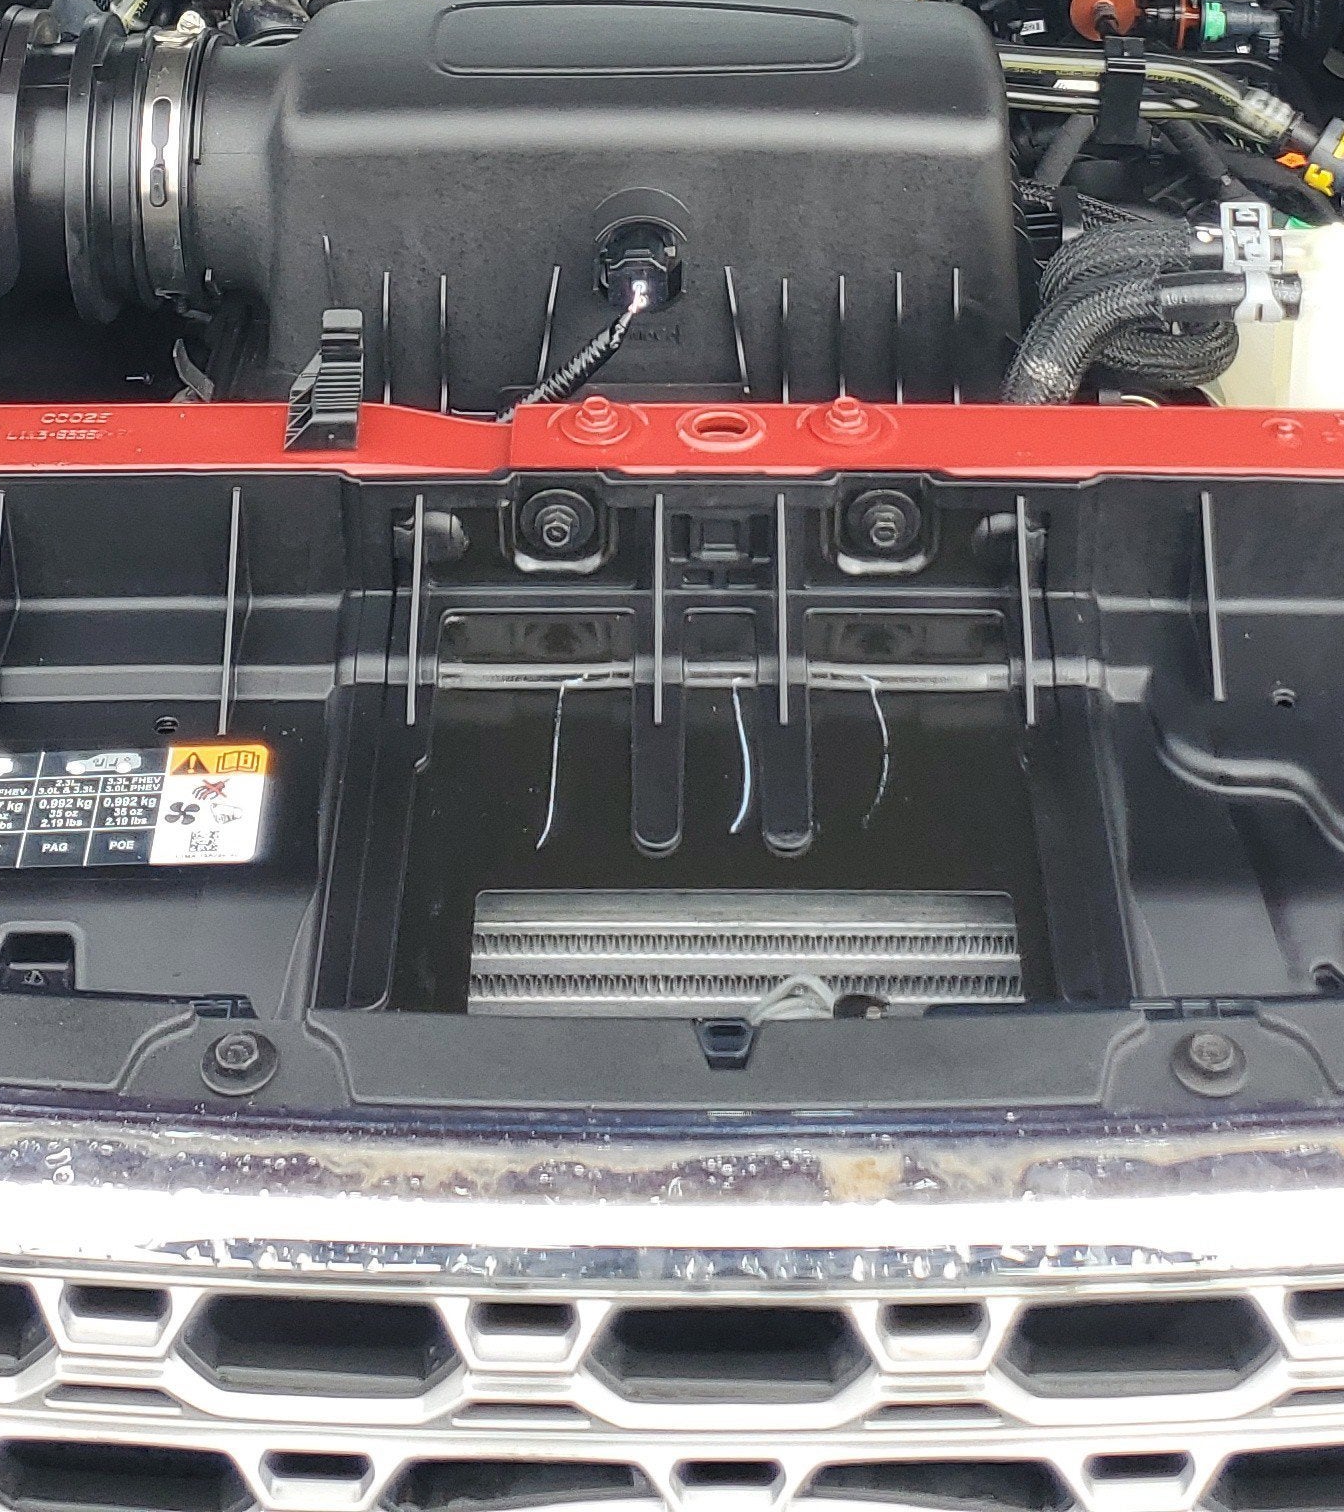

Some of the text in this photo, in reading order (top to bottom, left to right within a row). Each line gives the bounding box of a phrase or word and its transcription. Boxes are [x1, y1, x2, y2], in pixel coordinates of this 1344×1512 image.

[7, 801, 24, 812] kg
[76, 798, 93, 810] kg
[141, 796, 157, 808] kg
[49, 810, 63, 818] 35
[40, 818, 83, 827] 2.19 lbs
[130, 816, 148, 825] lbs
[41, 843, 68, 853] PAG
[108, 840, 135, 850] POE
